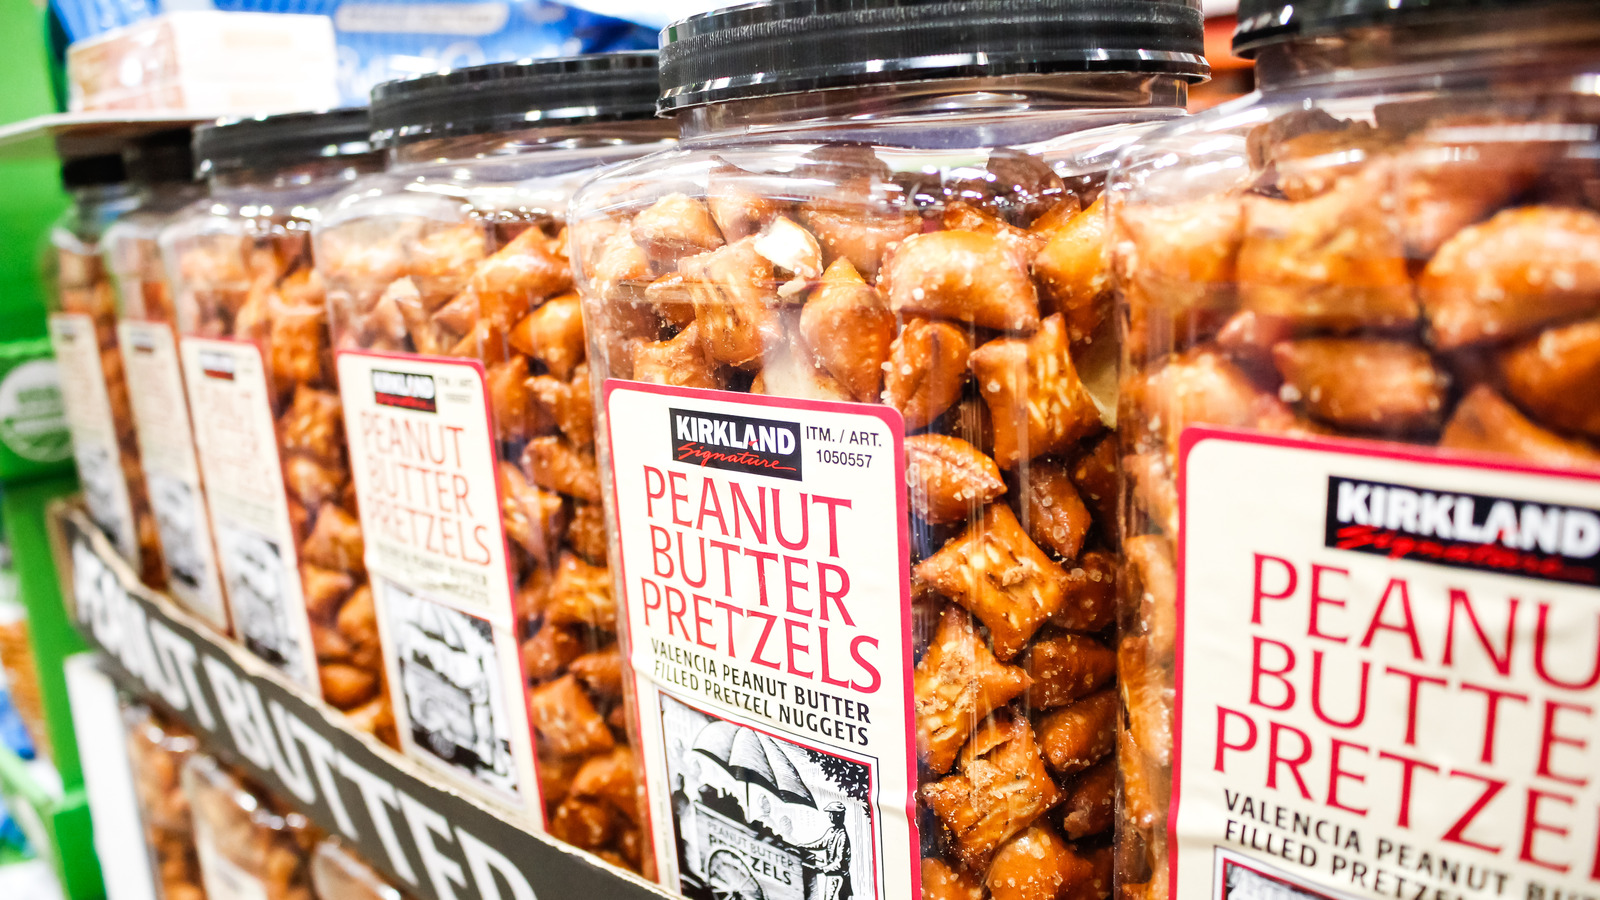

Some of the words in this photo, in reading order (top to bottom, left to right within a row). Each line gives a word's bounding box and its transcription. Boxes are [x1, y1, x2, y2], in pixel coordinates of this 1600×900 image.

[360, 410, 464, 468] PEANUT
[676, 415, 796, 455] KIRKLAND
[678, 442, 797, 471] Signature
[806, 426, 835, 442] ITM.
[849, 430, 882, 447] ART.
[816, 449, 872, 468] 1050557
[367, 454, 473, 517] BUTTER
[643, 464, 852, 558] PEANUT
[1337, 480, 1600, 558] KIRKLAND
[649, 524, 856, 627] BUTTER
[641, 577, 881, 694] PRETZELS
[651, 637, 717, 678] VALENCIA
[723, 664, 787, 700] PEANUT
[794, 686, 872, 724] BUTTER
[654, 660, 699, 691] FILLED
[705, 679, 772, 718] PRETZEL
[779, 704, 869, 746] NUGGETS
[708, 833, 792, 886] PZELS
[1224, 789, 1361, 853] VALENCIA
[1377, 838, 1510, 896] PEANUT
[1225, 819, 1317, 868] FILLED
[1331, 854, 1462, 900] PRETZ
